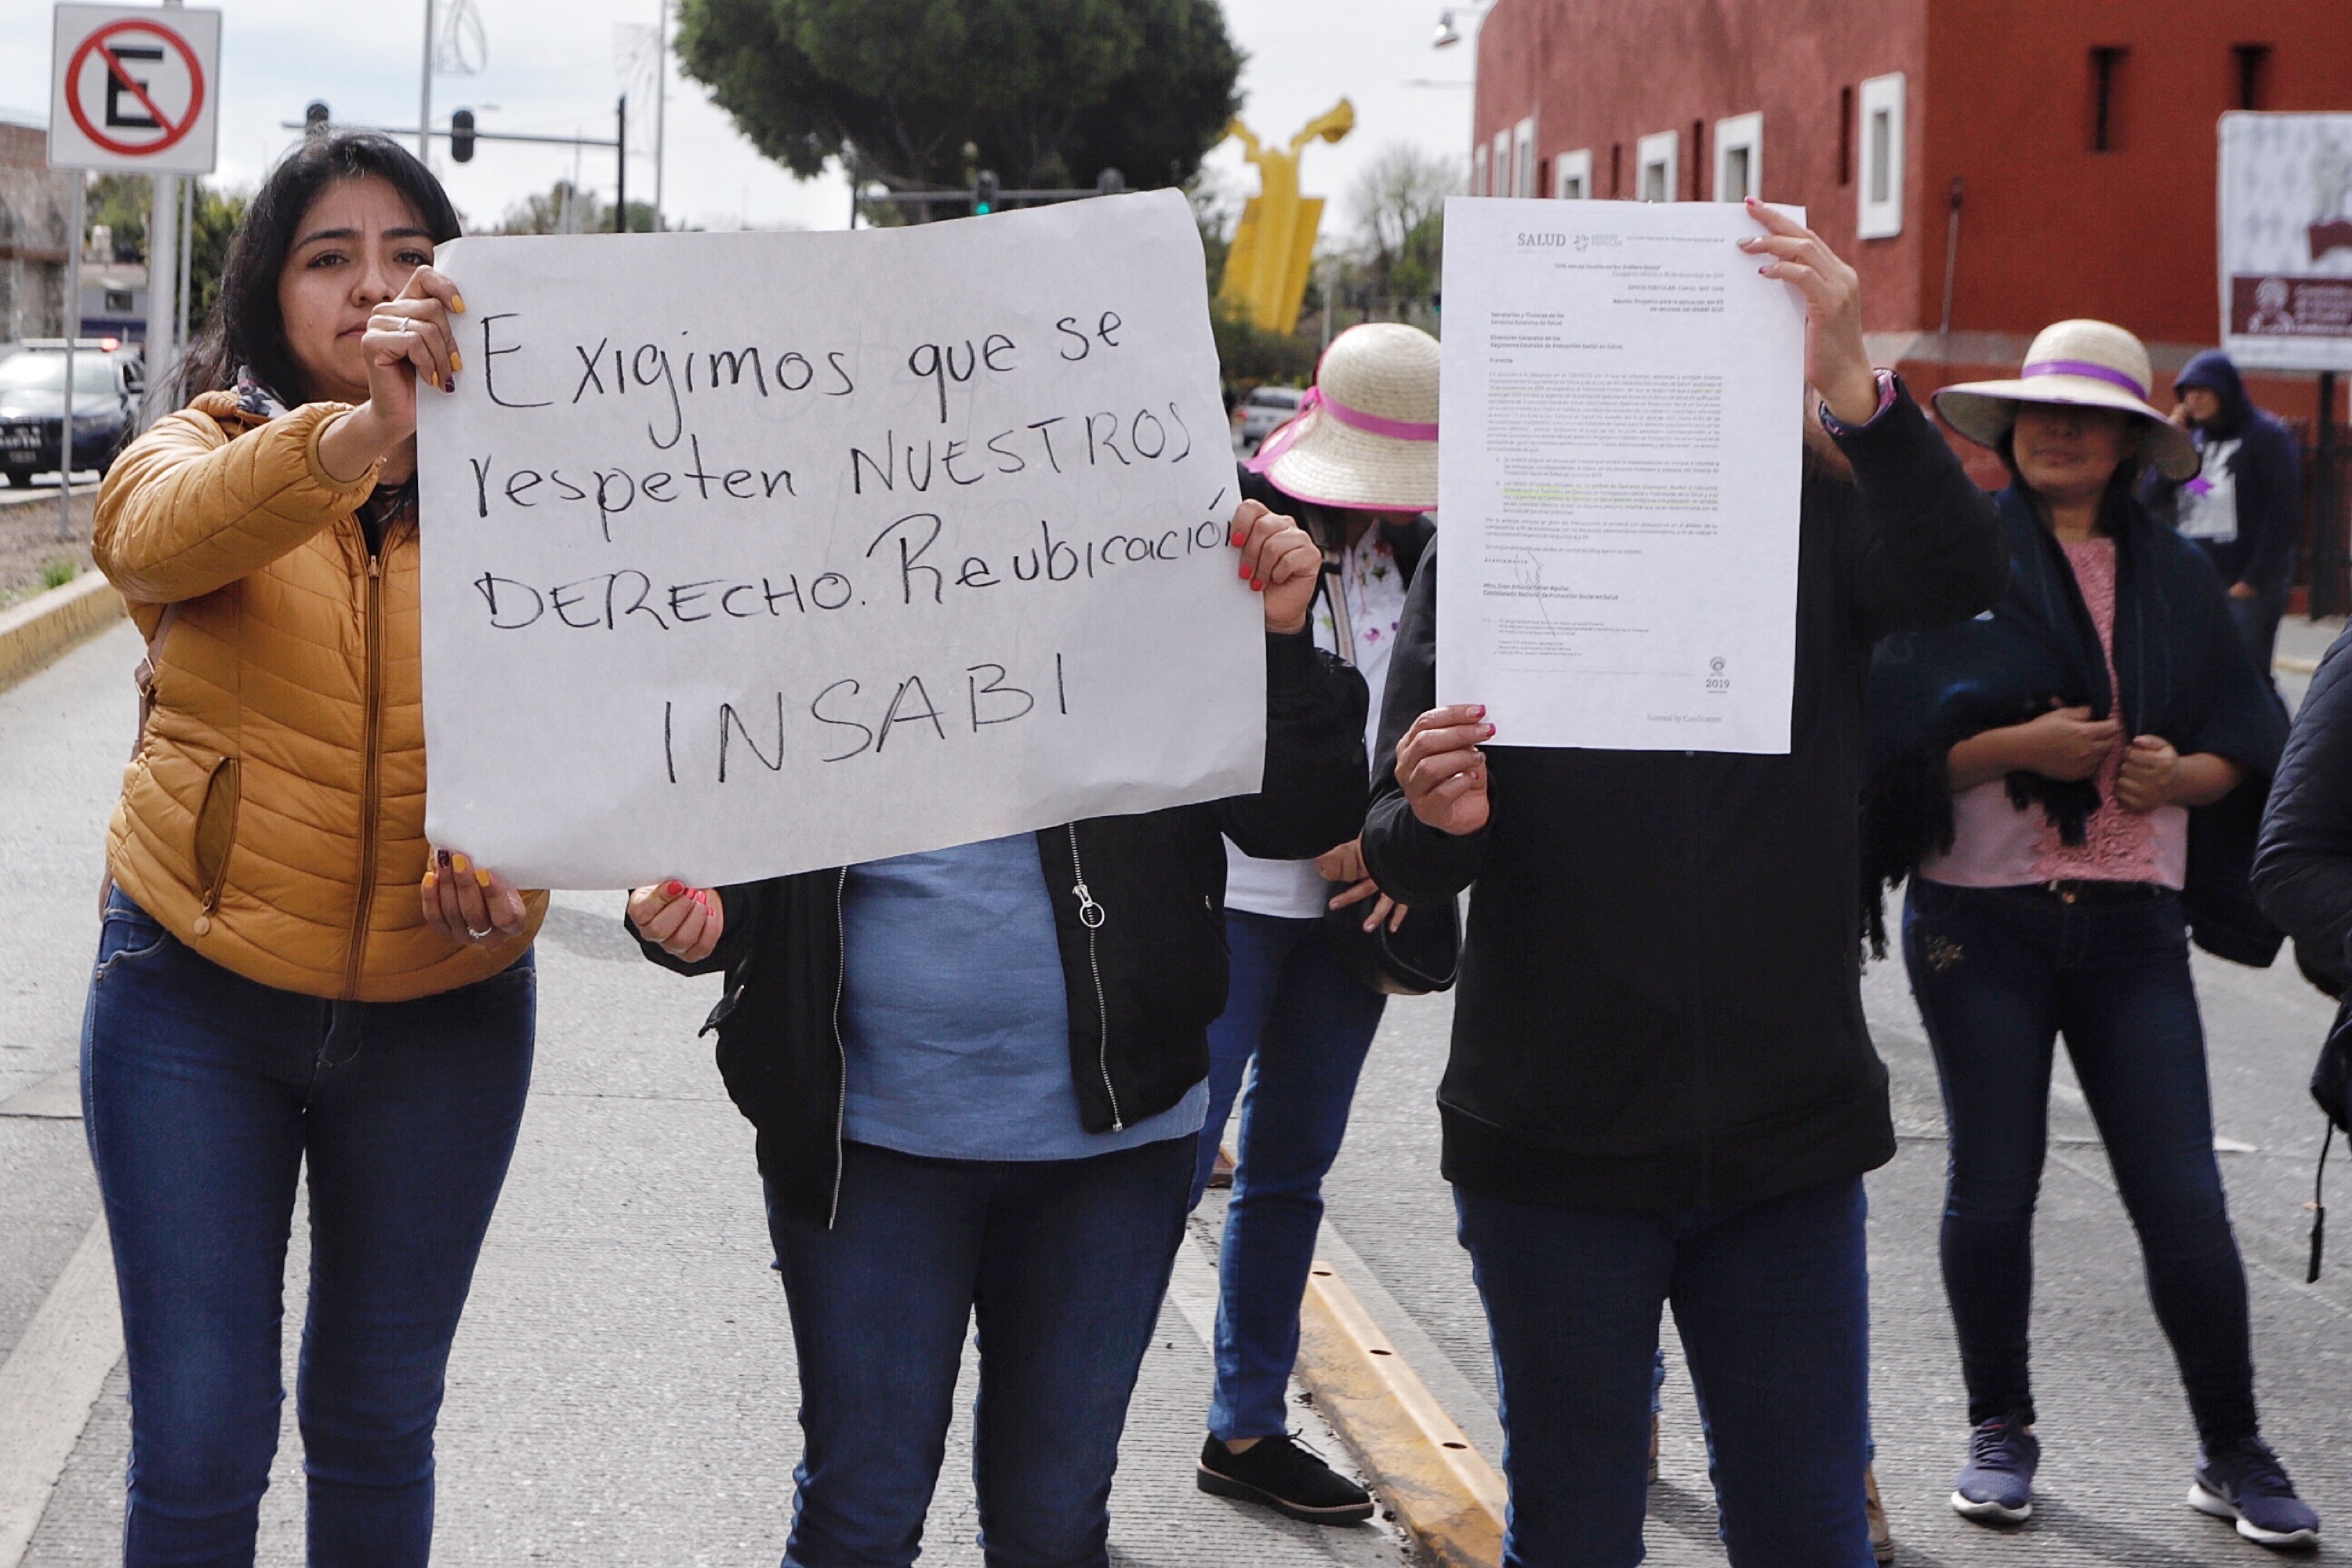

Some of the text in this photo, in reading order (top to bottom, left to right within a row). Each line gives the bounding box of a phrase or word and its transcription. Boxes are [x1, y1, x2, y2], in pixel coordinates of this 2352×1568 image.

[105, 48, 163, 128] E
[1518, 232, 1566, 247] SALUD
[480, 311, 1122, 450] Exigimos que se
[469, 402, 1192, 543] respeten NUESTROS
[474, 569, 866, 630] DERECHO.
[664, 653, 1068, 784] INSABI
[1705, 678, 1730, 688] 2019
